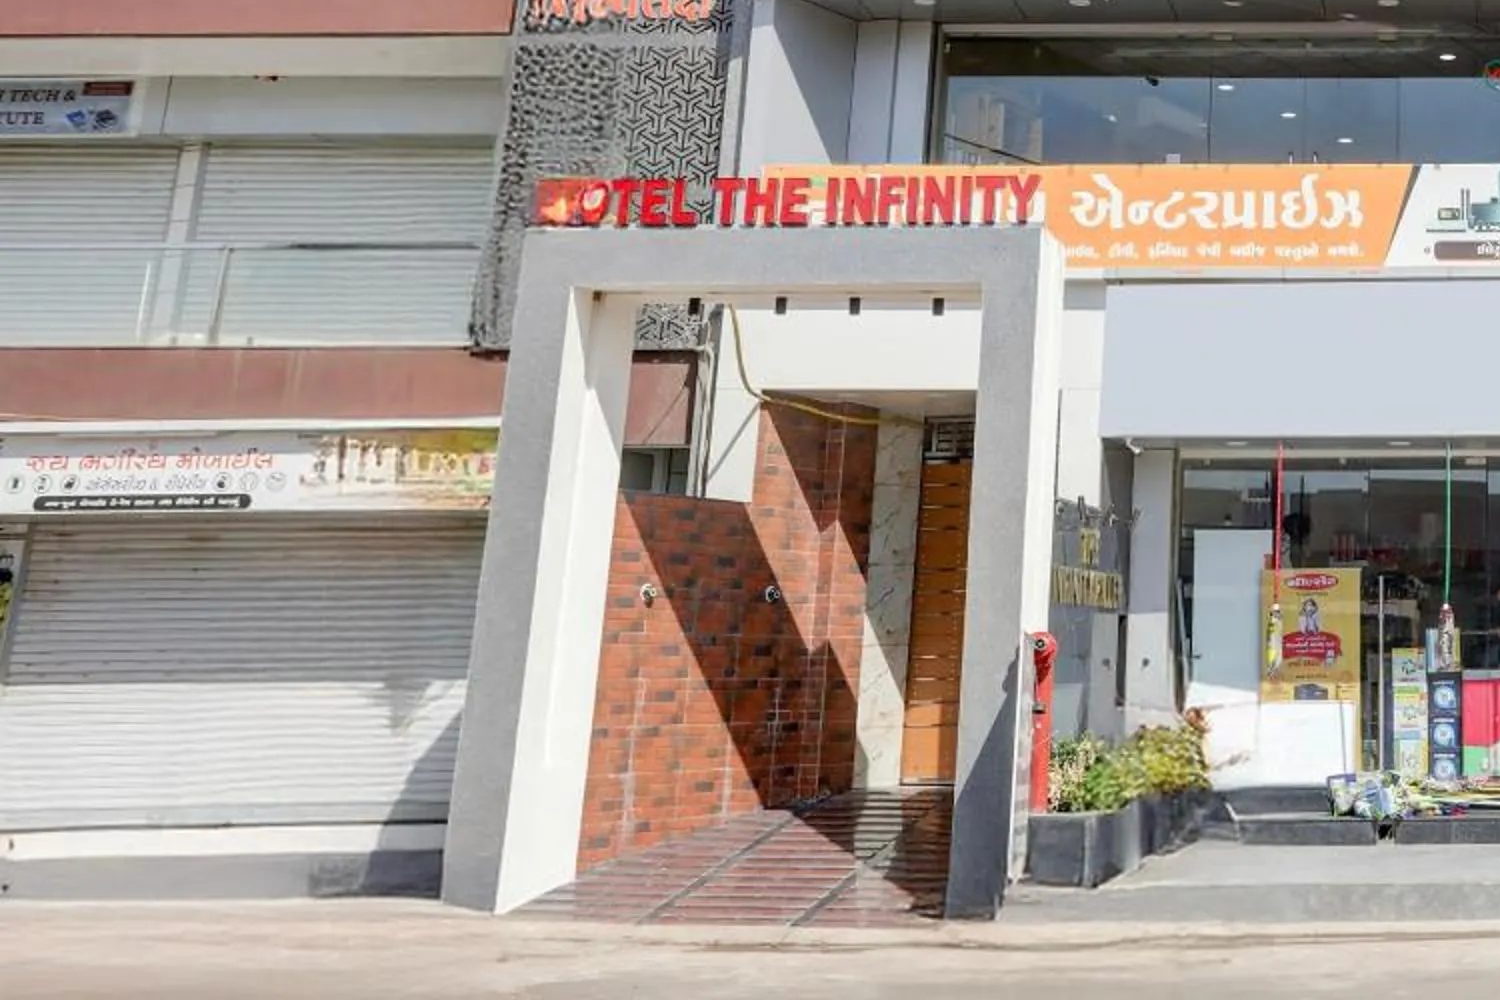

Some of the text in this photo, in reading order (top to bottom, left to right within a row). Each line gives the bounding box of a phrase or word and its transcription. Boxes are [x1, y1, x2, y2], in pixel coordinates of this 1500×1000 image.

[10, 89, 60, 103] TECH
[535, 173, 1044, 228] OTEL THE INFINITY
